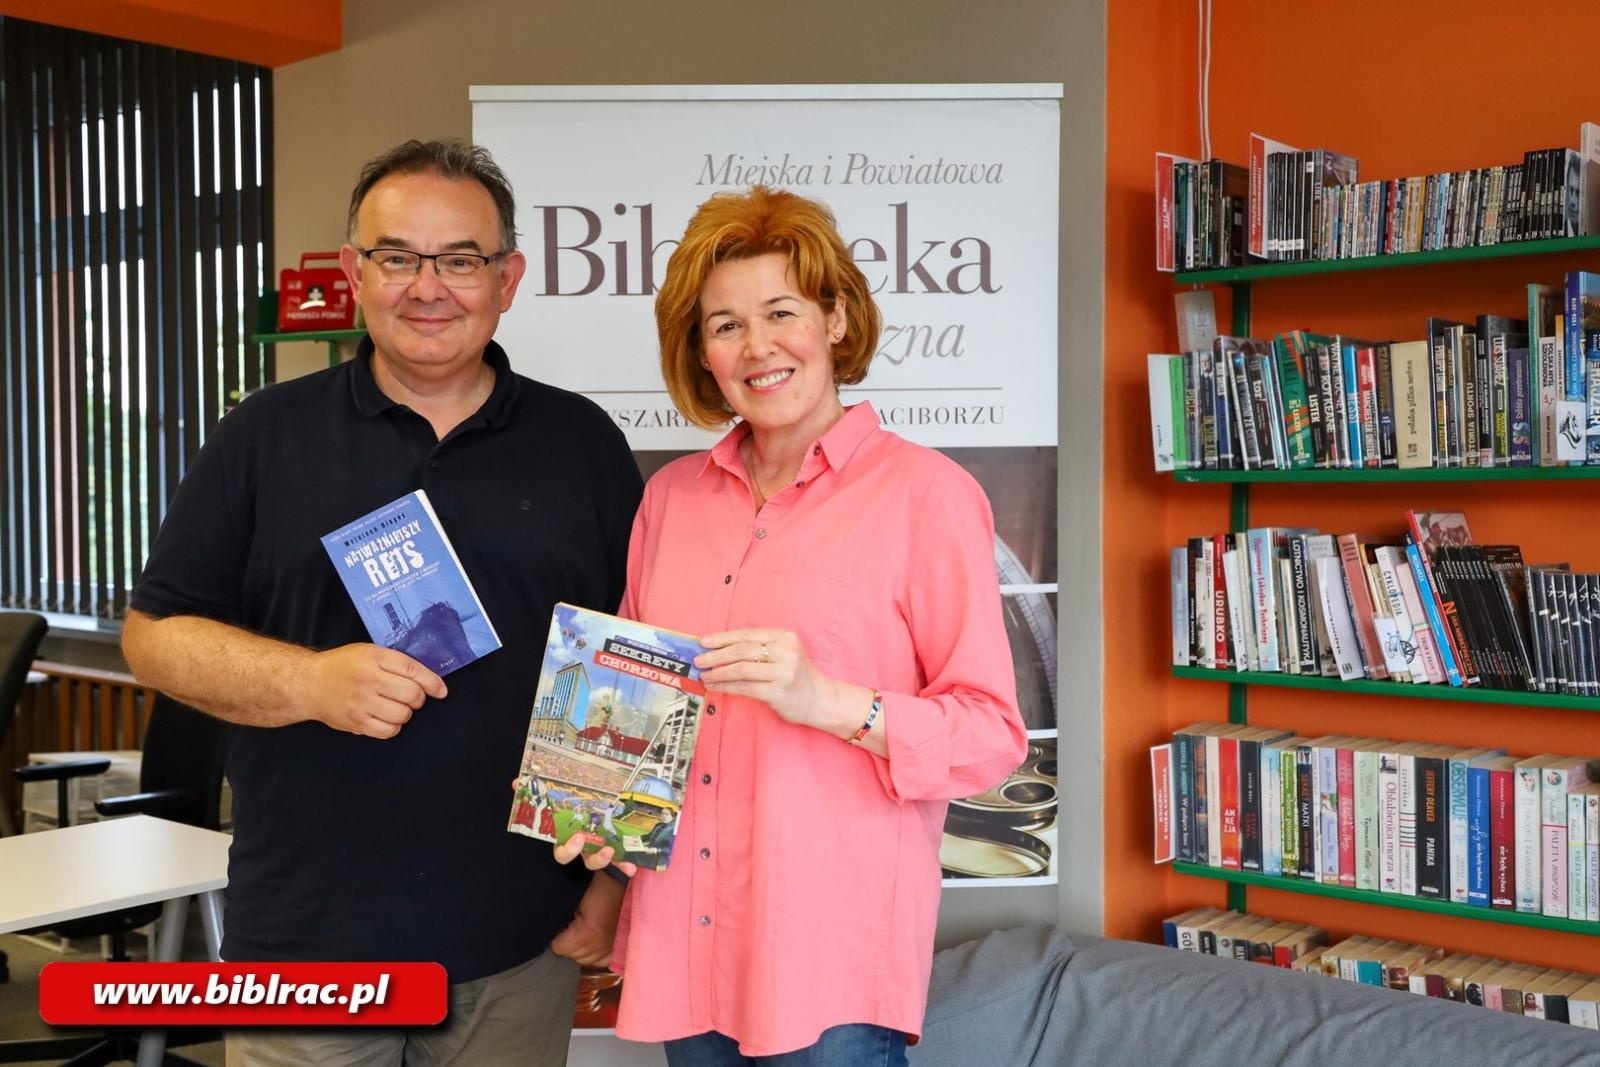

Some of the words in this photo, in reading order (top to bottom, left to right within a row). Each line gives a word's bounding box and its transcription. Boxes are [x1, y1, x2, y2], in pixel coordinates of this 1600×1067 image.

[696, 153, 813, 187] Miejska
[822, 155, 833, 186] i
[841, 152, 1003, 186] Powiatowa
[1331, 342, 1341, 375] WAYNE
[1321, 374, 1332, 397] ROY
[1466, 382, 1475, 418] SPORTU
[879, 405, 1005, 426] ACIBORZU
[1323, 397, 1335, 433] KEANE
[1363, 389, 1373, 433] MANCHESTER
[1292, 539, 1305, 588] LOTNICTWO
[1383, 570, 1403, 616] CYKLOPEDIA
[1444, 600, 1457, 615] N
[1215, 590, 1225, 642] URUBKO
[599, 653, 682, 689] CHORZOWA
[608, 641, 685, 673] SEKRETY
[1224, 809, 1236, 817] AM
[1224, 817, 1235, 826] NE
[1301, 802, 1310, 828] MATKI
[1385, 782, 1397, 840] Oblubienica
[1426, 796, 1436, 822] DEAVER
[1223, 825, 1237, 834] ZJA
[1386, 841, 1396, 872] morza
[1426, 837, 1436, 866] PANIKA
[1499, 845, 1509, 857] nie
[1551, 829, 1560, 863] PALETA
